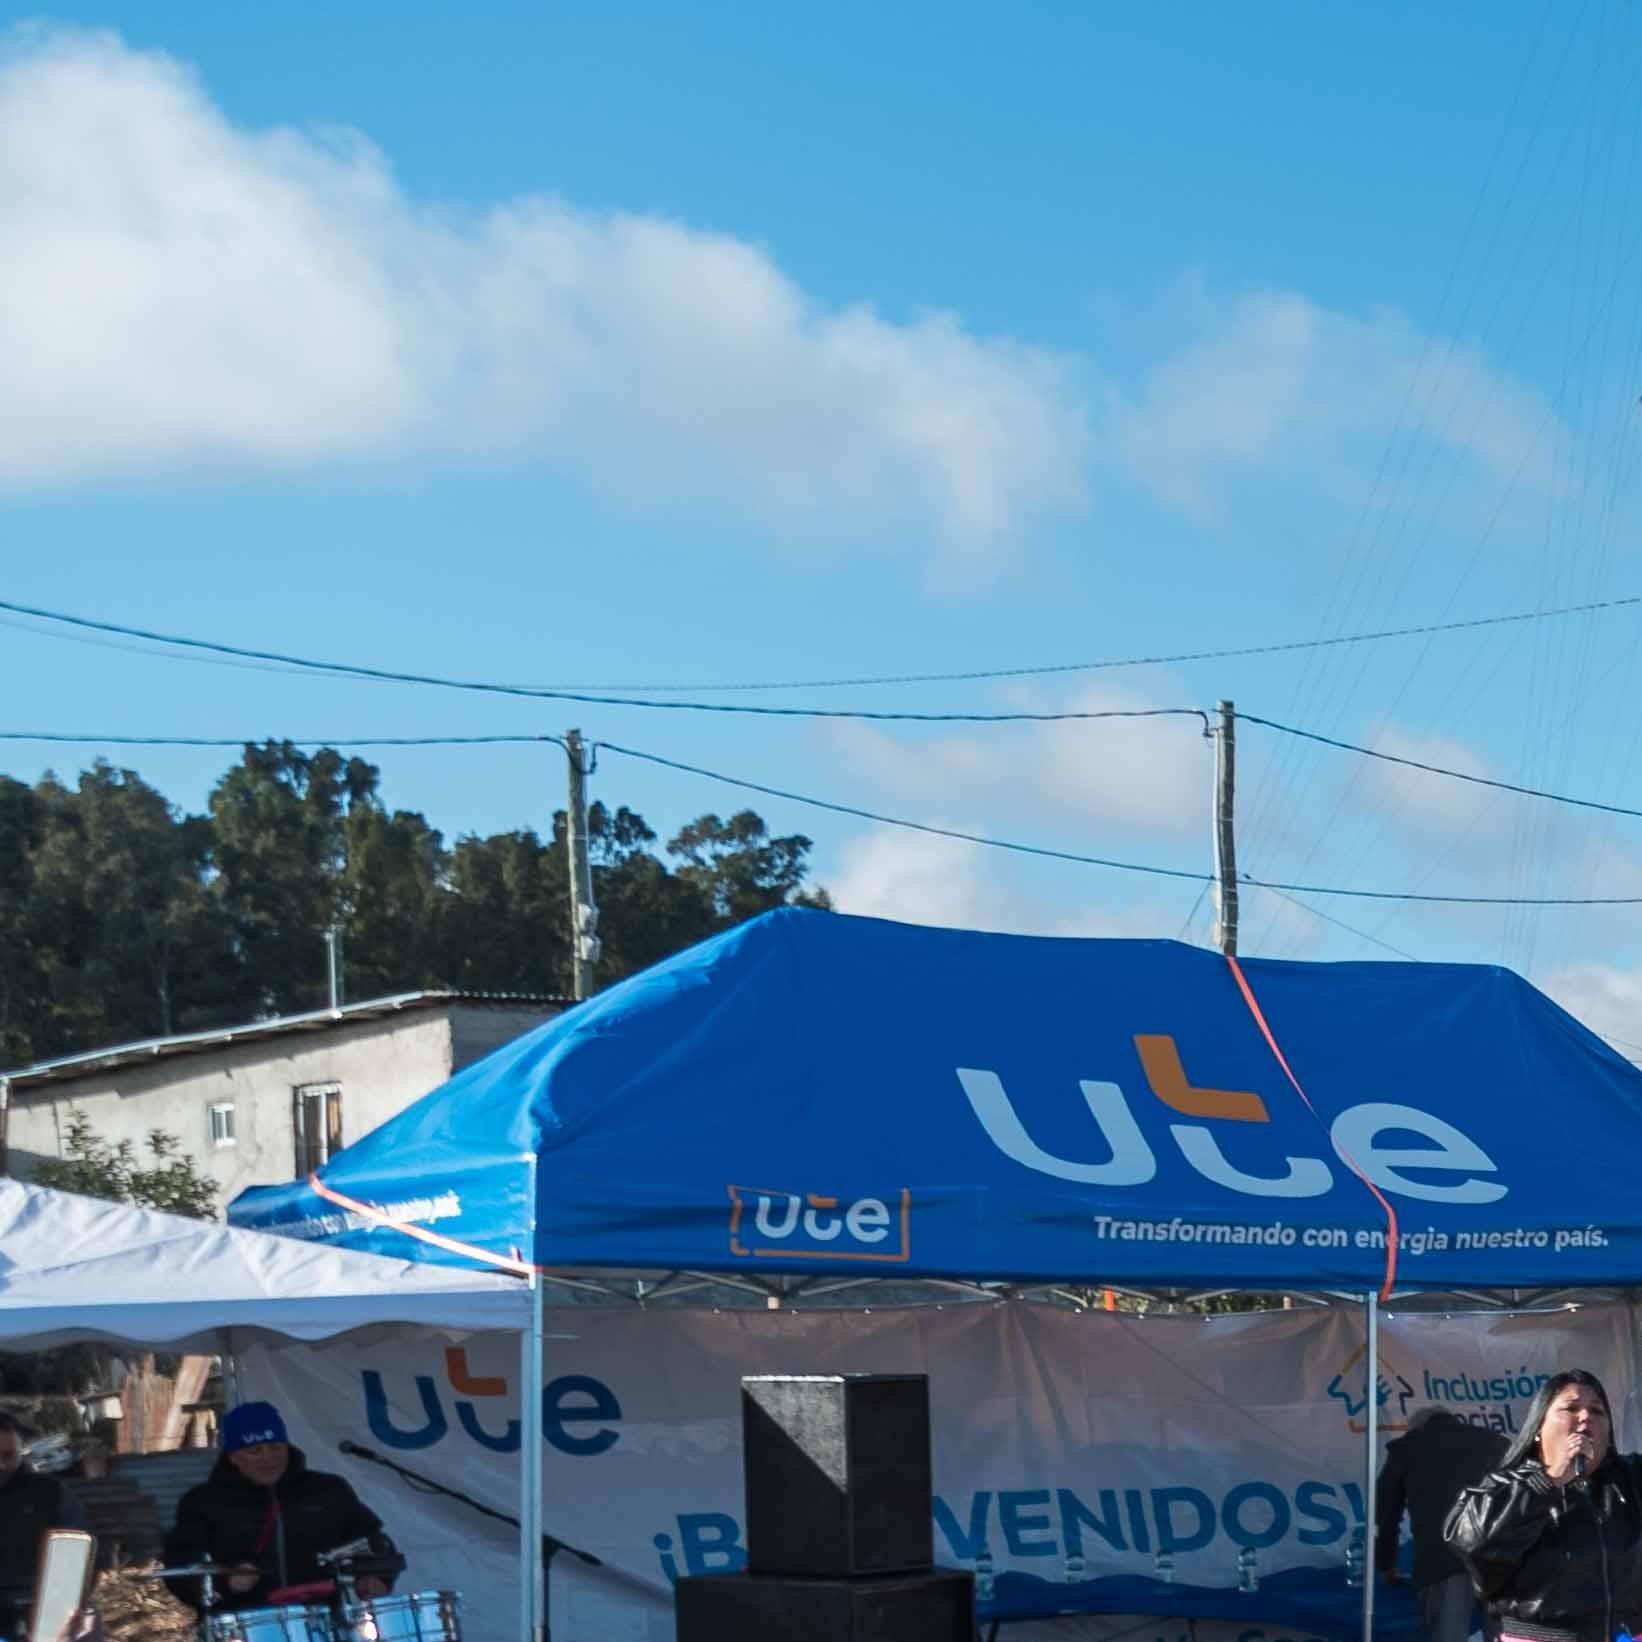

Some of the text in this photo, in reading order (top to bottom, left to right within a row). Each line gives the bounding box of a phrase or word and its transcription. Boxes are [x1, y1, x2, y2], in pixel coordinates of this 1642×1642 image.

[955, 1033, 1510, 1204] ute
[755, 1193, 890, 1243] ute
[1094, 1215, 1297, 1246] Transformando
[1302, 1226, 1349, 1248] con
[1455, 1228, 1549, 1249] nuestro
[1554, 1224, 1609, 1252] país.
[361, 1345, 623, 1457] ute
